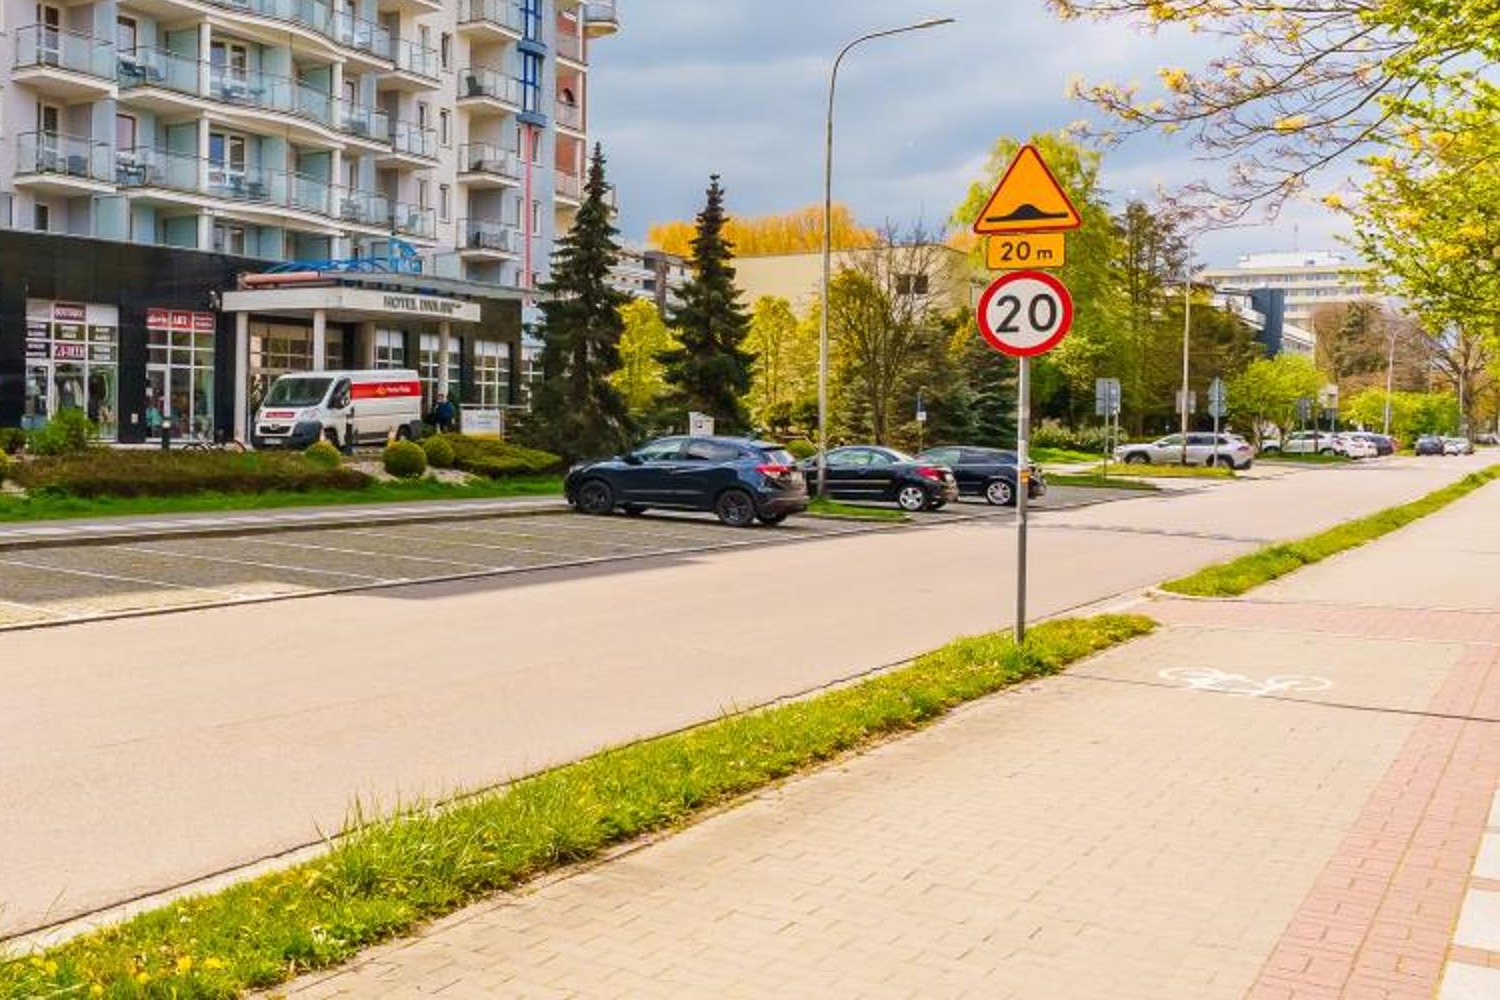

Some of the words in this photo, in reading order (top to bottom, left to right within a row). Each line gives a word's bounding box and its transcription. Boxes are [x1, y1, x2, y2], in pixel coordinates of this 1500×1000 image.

[1001, 241, 1031, 261] 20
[1037, 249, 1053, 260] m
[383, 296, 418, 311] HOTEL
[996, 294, 1057, 333] 20
